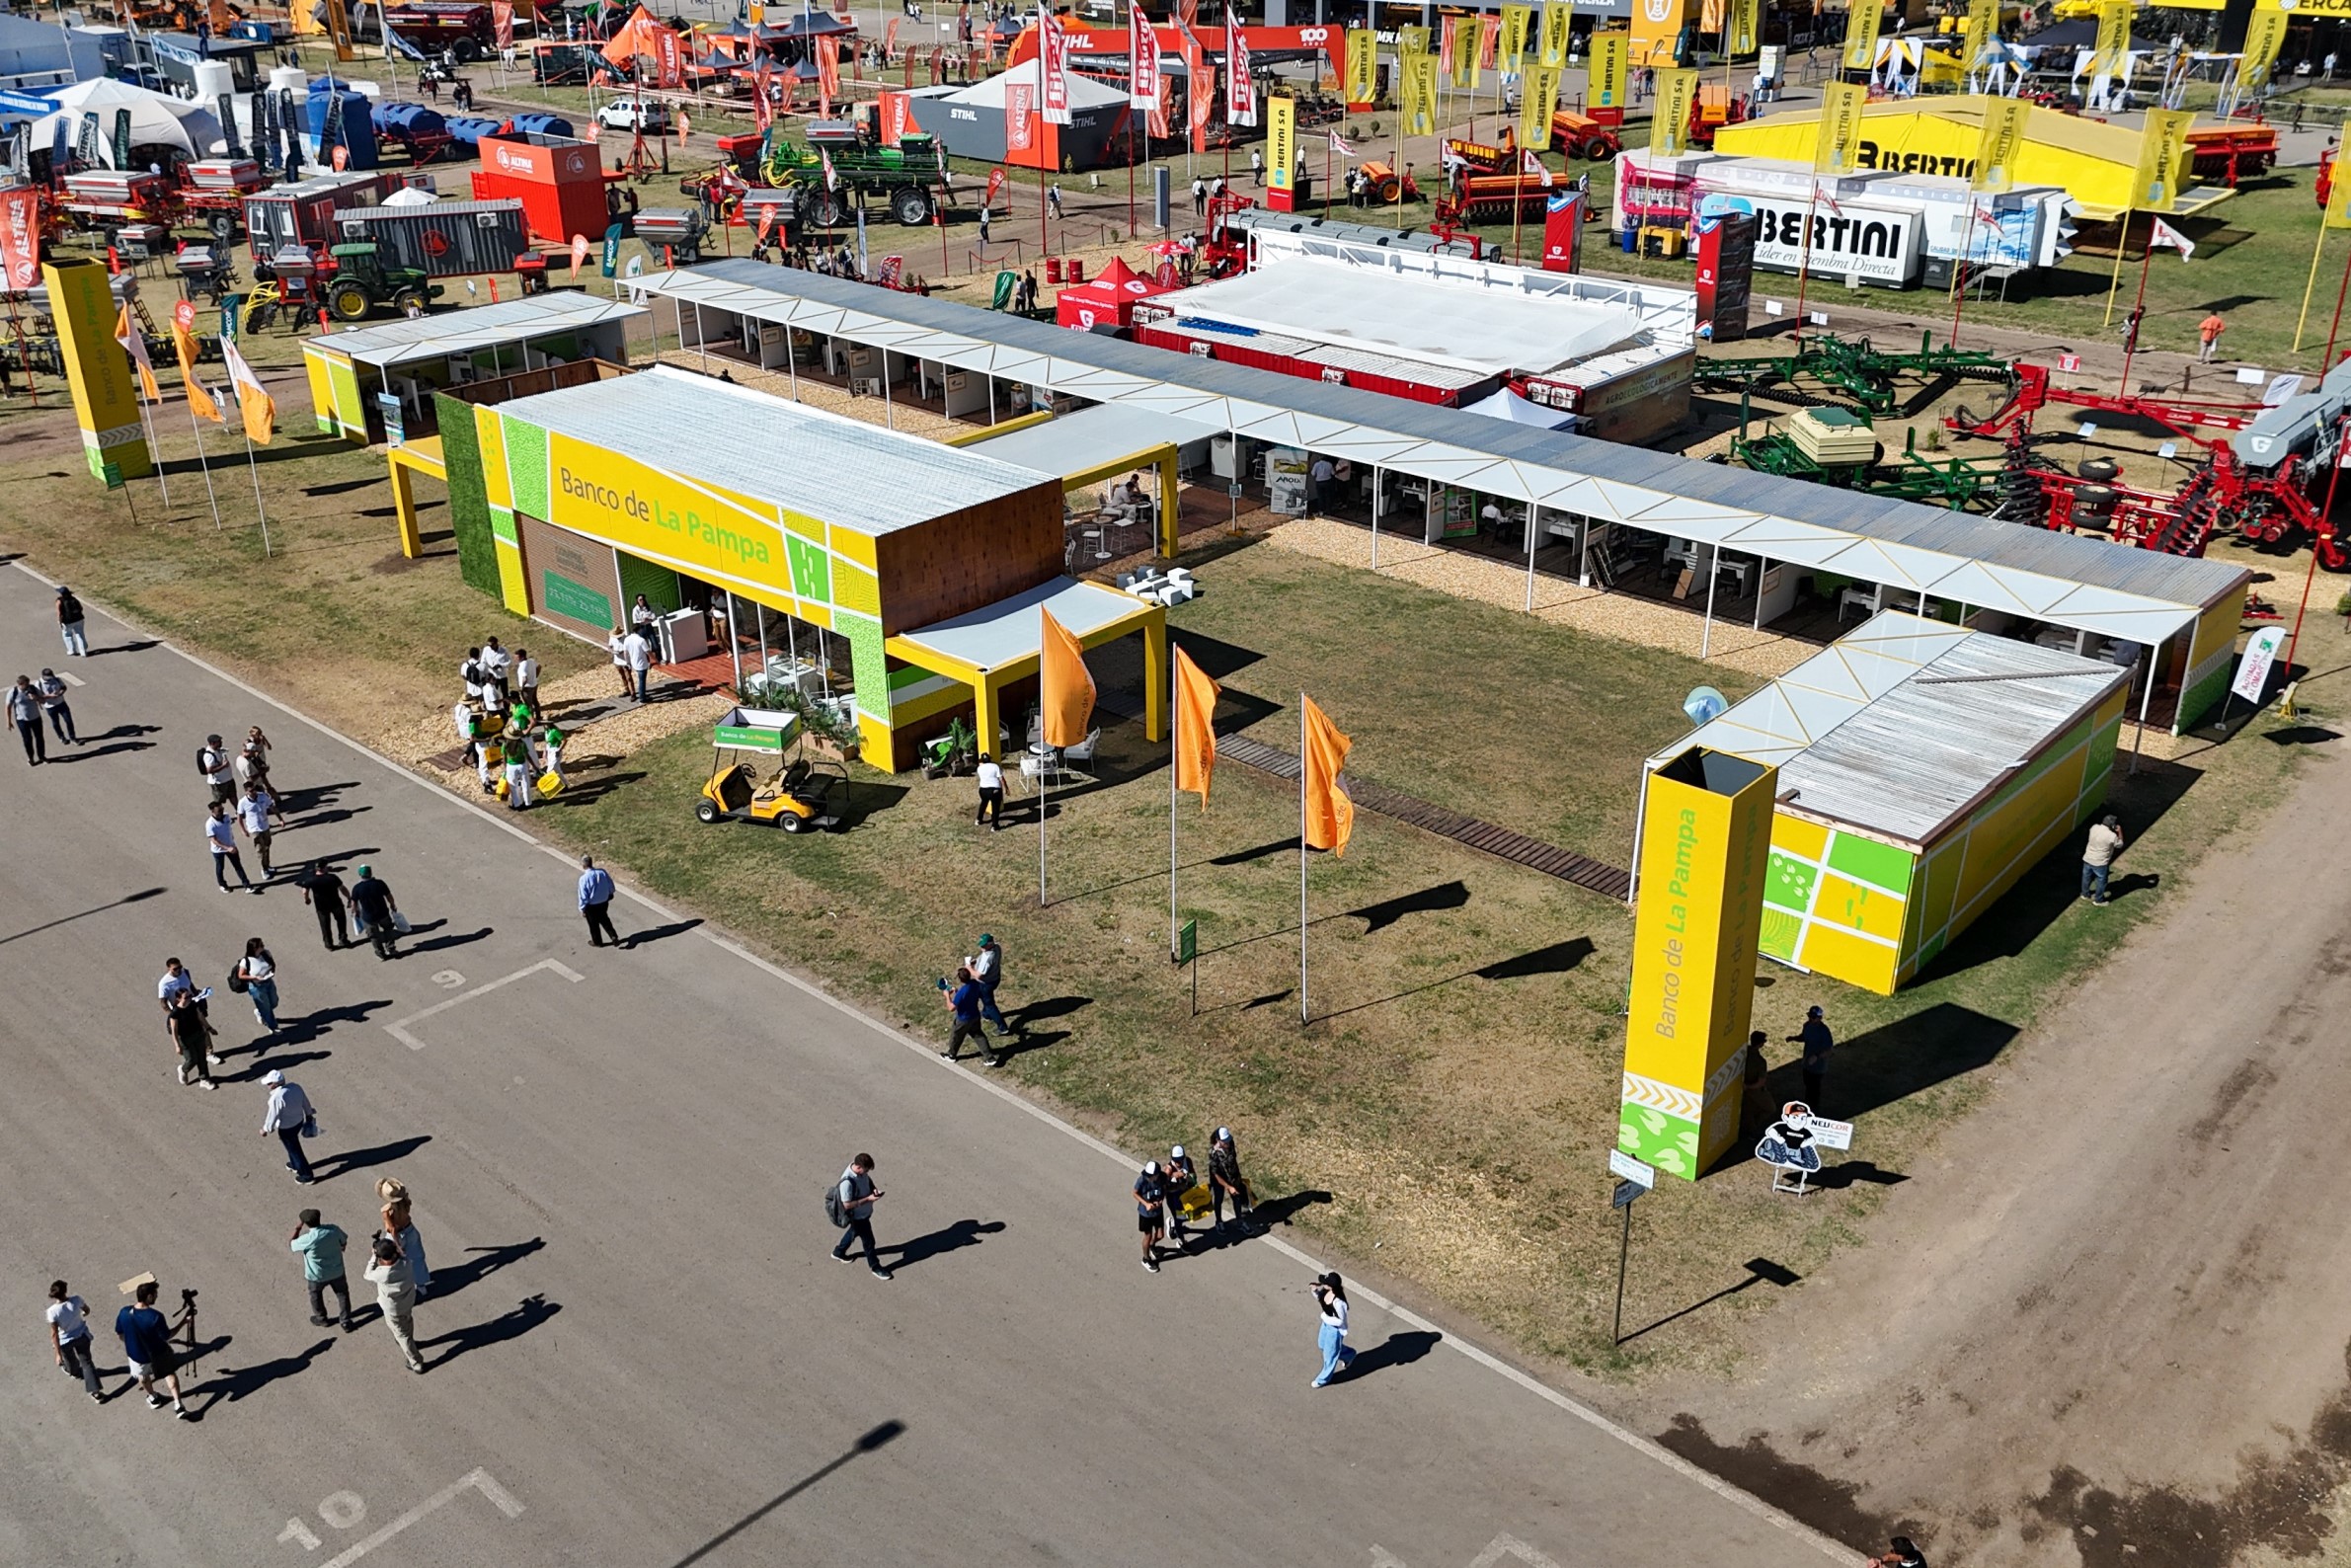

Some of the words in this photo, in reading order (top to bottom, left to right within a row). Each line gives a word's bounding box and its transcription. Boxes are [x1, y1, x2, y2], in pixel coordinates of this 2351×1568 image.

[664, 33, 676, 68] ALTINA
[1061, 35, 1094, 48] IHL
[1299, 28, 1328, 42] 100
[1606, 55, 1614, 91] BERTINI
[895, 97, 904, 136] ALTINA
[950, 108, 978, 121] STIHL
[1015, 87, 1027, 127] ALTINA
[1068, 115, 1097, 130] STIHL
[1536, 91, 1547, 126] BERTINI
[1670, 97, 1681, 134] BERTINI
[1837, 106, 1850, 149] BERTINI
[1993, 124, 2010, 166] BERTINI
[21, 123, 32, 178] WATERDOG
[2155, 139, 2174, 183] BERTINI
[8, 199, 31, 258] ALTINA
[1755, 208, 1902, 259] BERTINI
[1754, 245, 1781, 260] Líder
[1783, 252, 1797, 263] en
[1850, 257, 1897, 275] Directa
[81, 275, 98, 326] Pampa
[96, 349, 109, 364] de
[101, 367, 116, 406] Banco
[560, 466, 620, 511] Banco
[624, 490, 650, 522] de
[654, 499, 681, 533] La
[688, 511, 770, 565] Pampa
[1669, 808, 1699, 899] Pampa
[1739, 804, 1758, 895] Pampa
[1665, 902, 1687, 934] La
[1735, 899, 1749, 931] La
[1662, 939, 1684, 969] de
[1732, 934, 1744, 962] de
[1656, 973, 1680, 1039] Banco
[1724, 968, 1741, 1038] Banco
[1811, 1119, 1849, 1133] NEUCOR
[276, 1489, 368, 1551] 10
